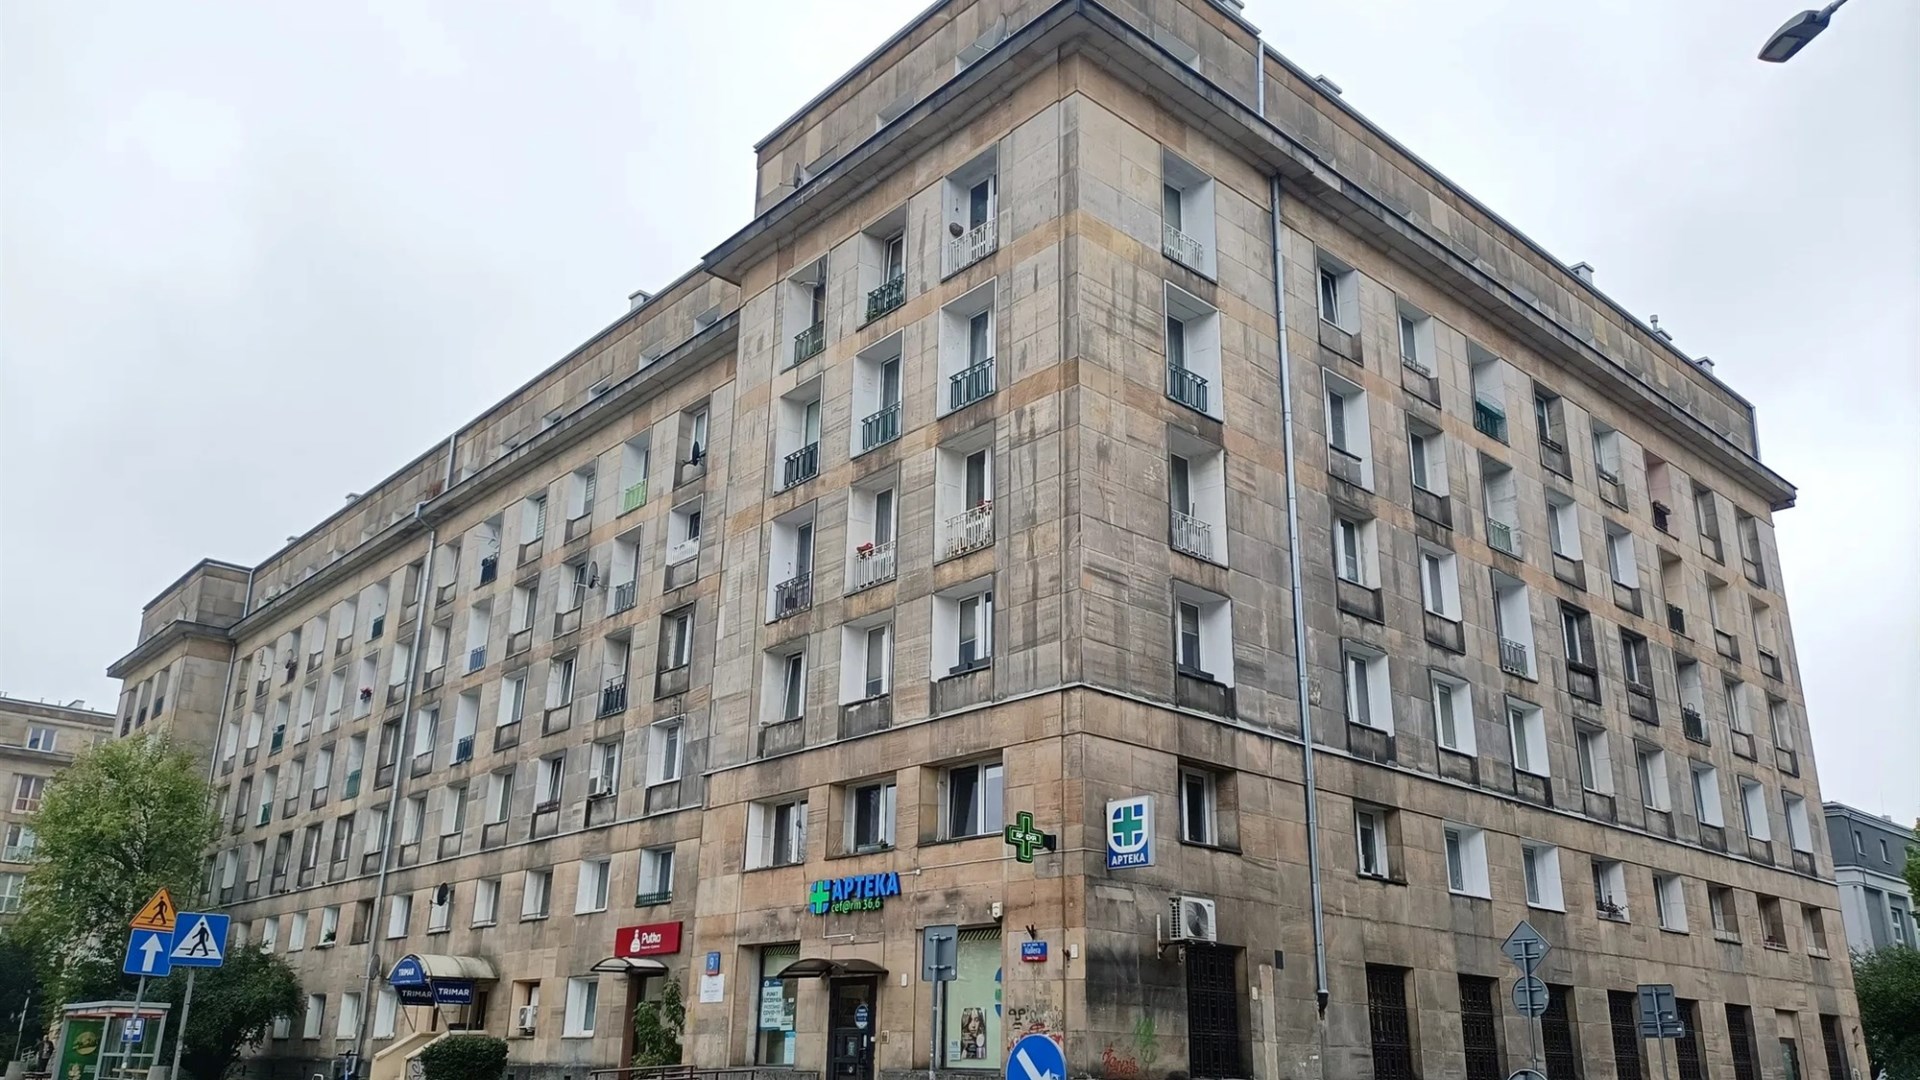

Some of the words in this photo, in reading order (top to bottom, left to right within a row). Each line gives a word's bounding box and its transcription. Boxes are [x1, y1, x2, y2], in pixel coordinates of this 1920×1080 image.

[1111, 853, 1146, 866] APTEKA
[832, 872, 898, 901] APTEKA
[398, 968, 415, 976] TRIMAR
[402, 990, 433, 998] TRIMAR
[438, 987, 470, 996] TRIMAR
